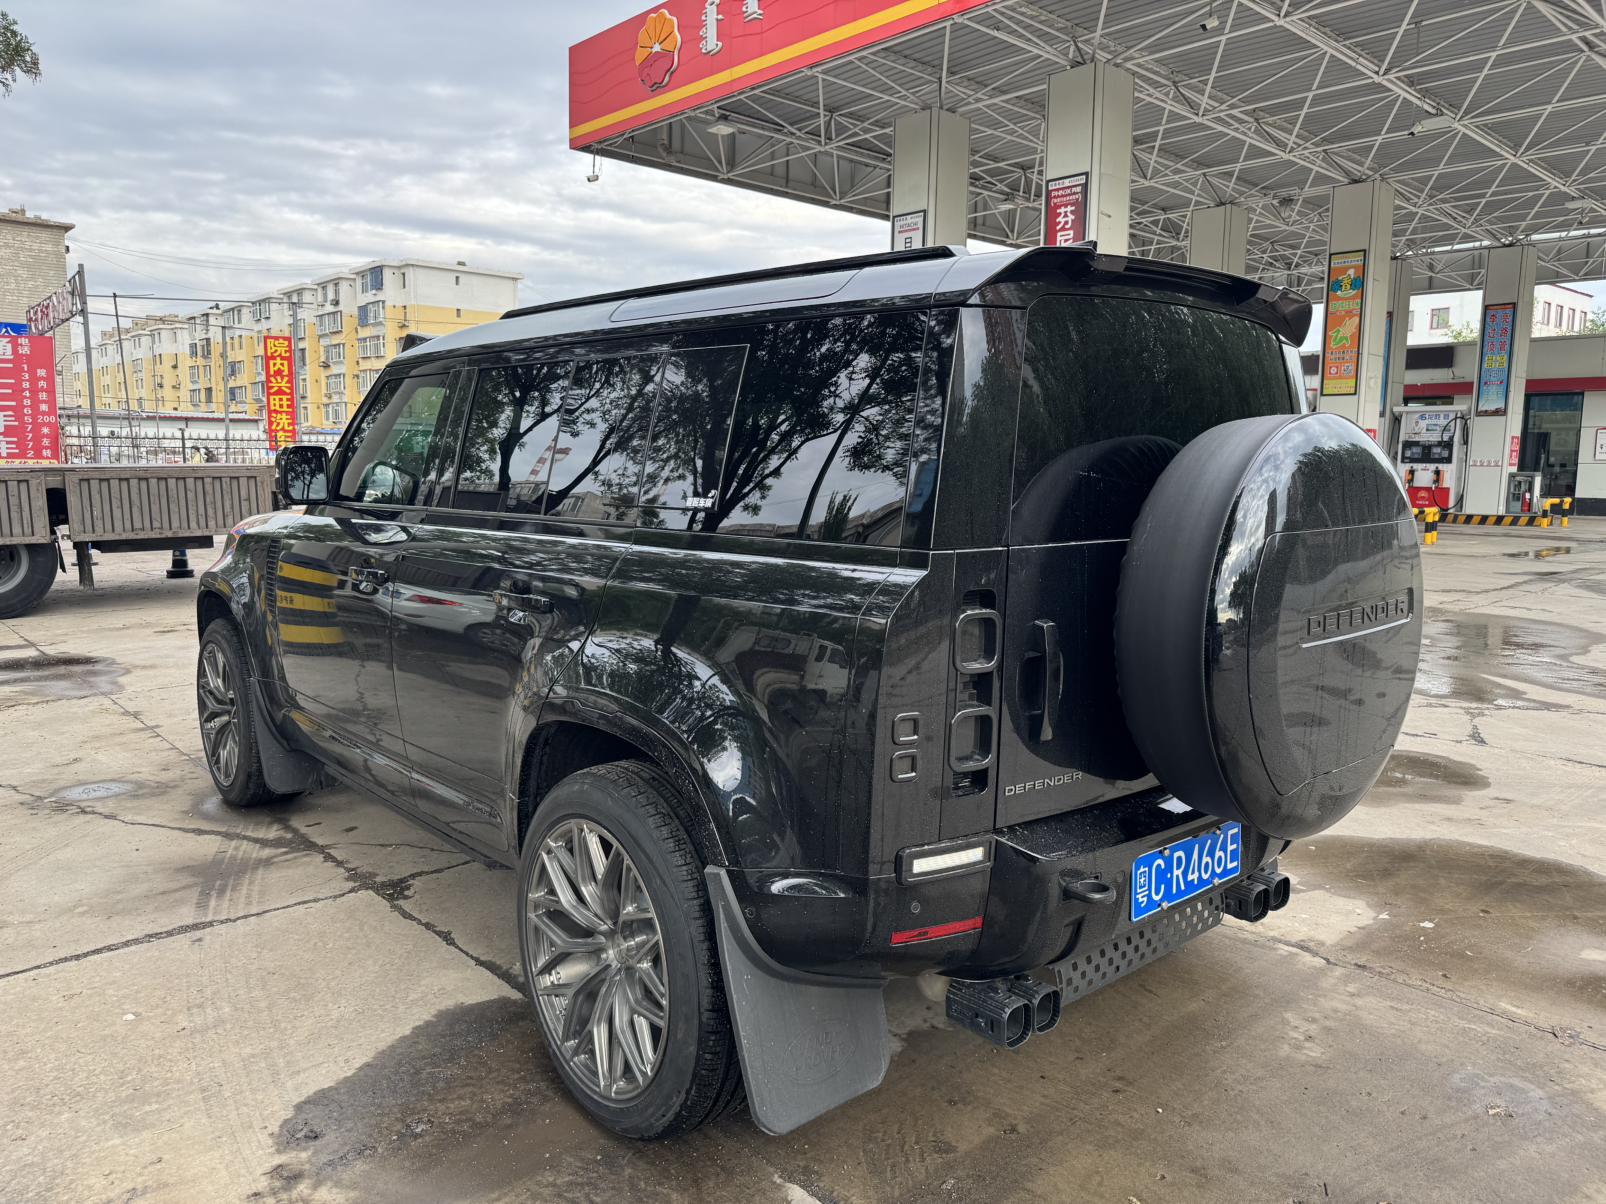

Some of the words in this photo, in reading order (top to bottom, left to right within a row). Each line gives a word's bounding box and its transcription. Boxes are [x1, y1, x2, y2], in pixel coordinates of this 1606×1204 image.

[1056, 205, 1075, 247] 芬尼
[266, 338, 293, 448] 院内兴旺洗车
[1307, 597, 1405, 636] DEFENDER
[1005, 771, 1082, 796] DEFENDER
